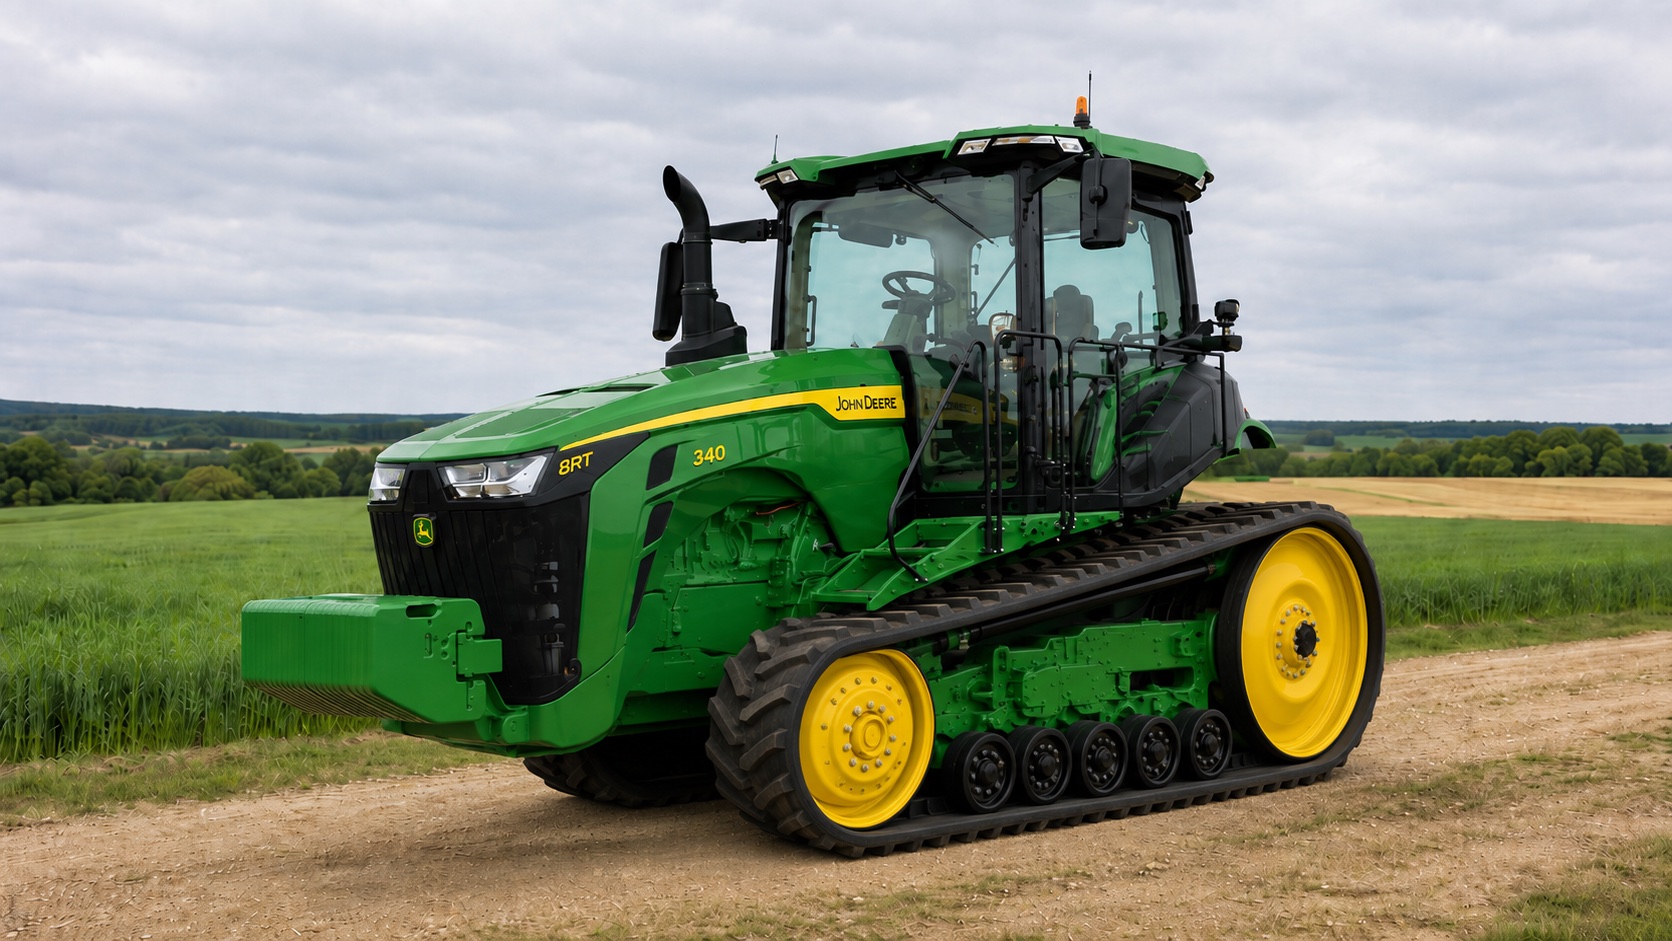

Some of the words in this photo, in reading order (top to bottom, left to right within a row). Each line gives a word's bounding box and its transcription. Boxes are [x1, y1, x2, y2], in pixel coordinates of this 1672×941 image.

[836, 395, 863, 411] JOHN
[864, 395, 897, 409] DEERE
[558, 451, 594, 476] 8RT
[693, 444, 726, 466] 340
